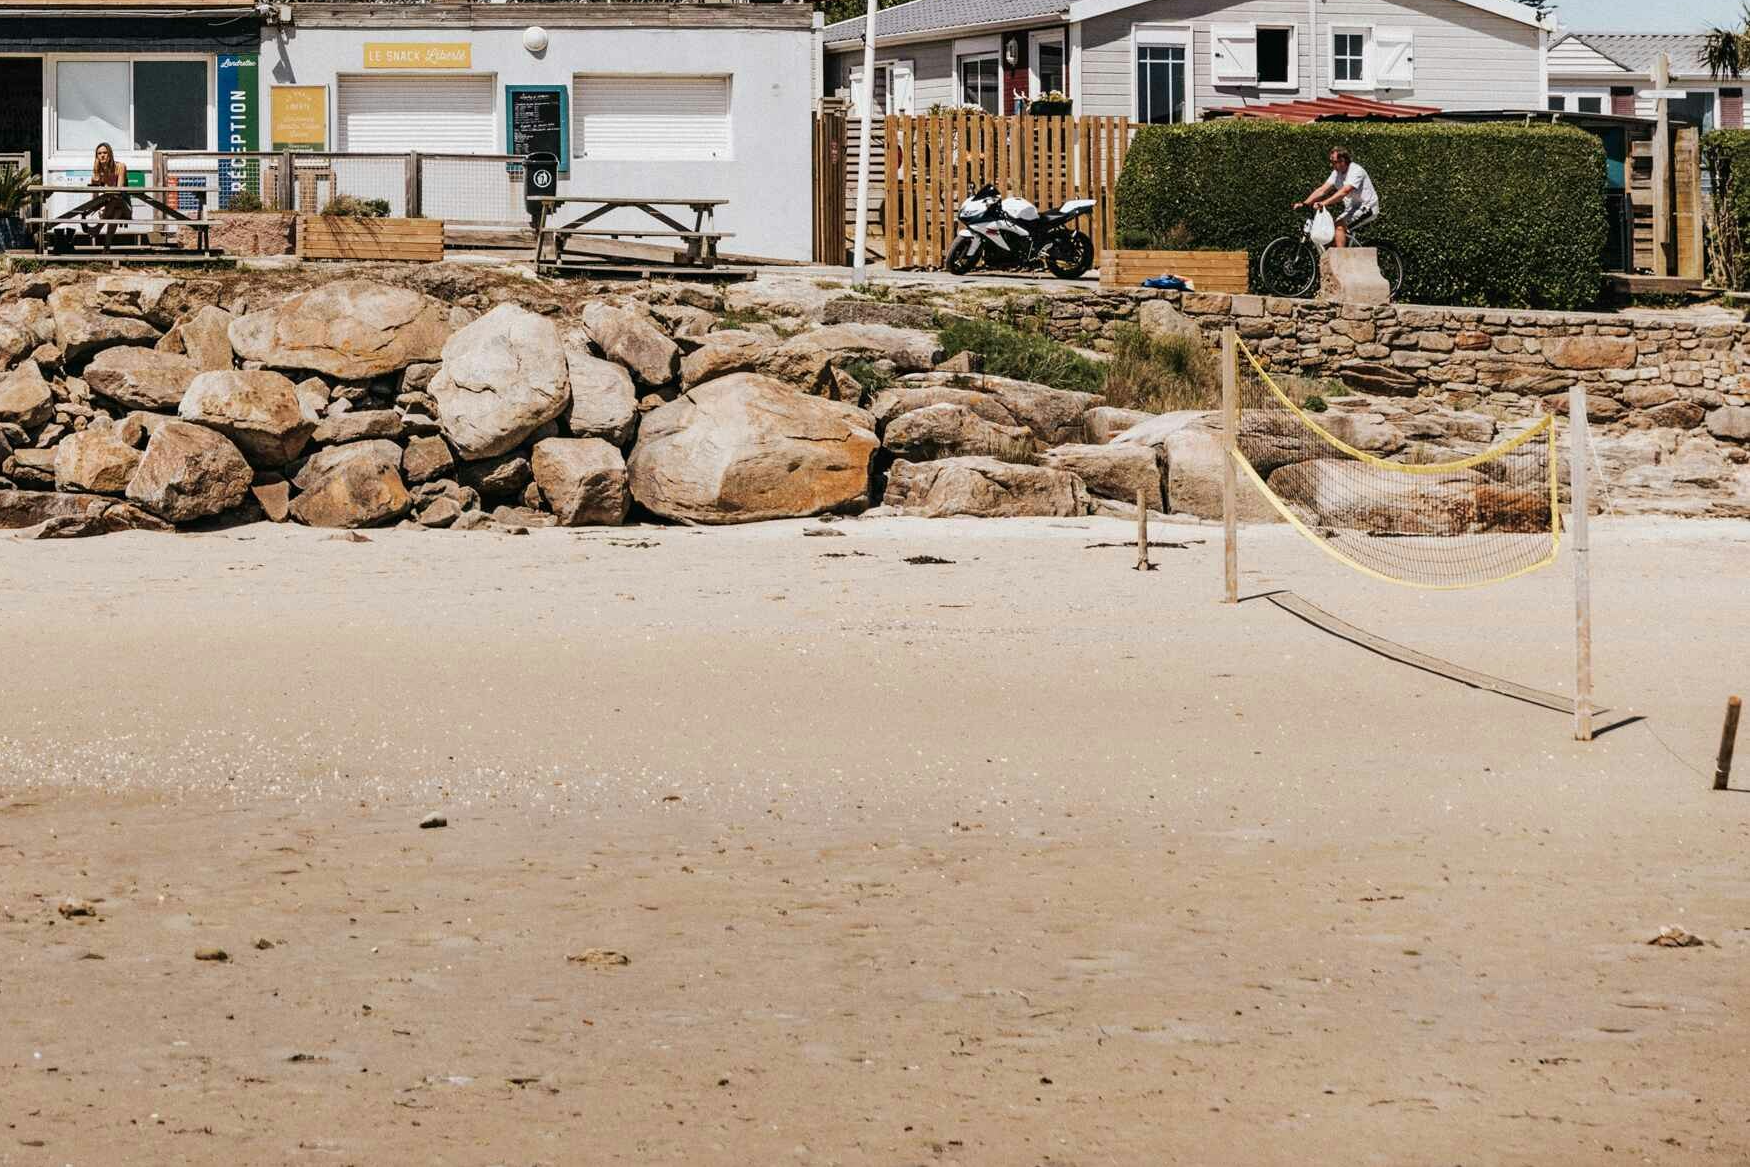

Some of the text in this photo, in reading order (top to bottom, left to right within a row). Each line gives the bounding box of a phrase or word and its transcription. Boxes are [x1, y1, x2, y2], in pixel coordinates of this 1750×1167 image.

[369, 50, 381, 61] LE
[386, 50, 420, 61] SNACK
[227, 91, 247, 192] RÉCEPTION
